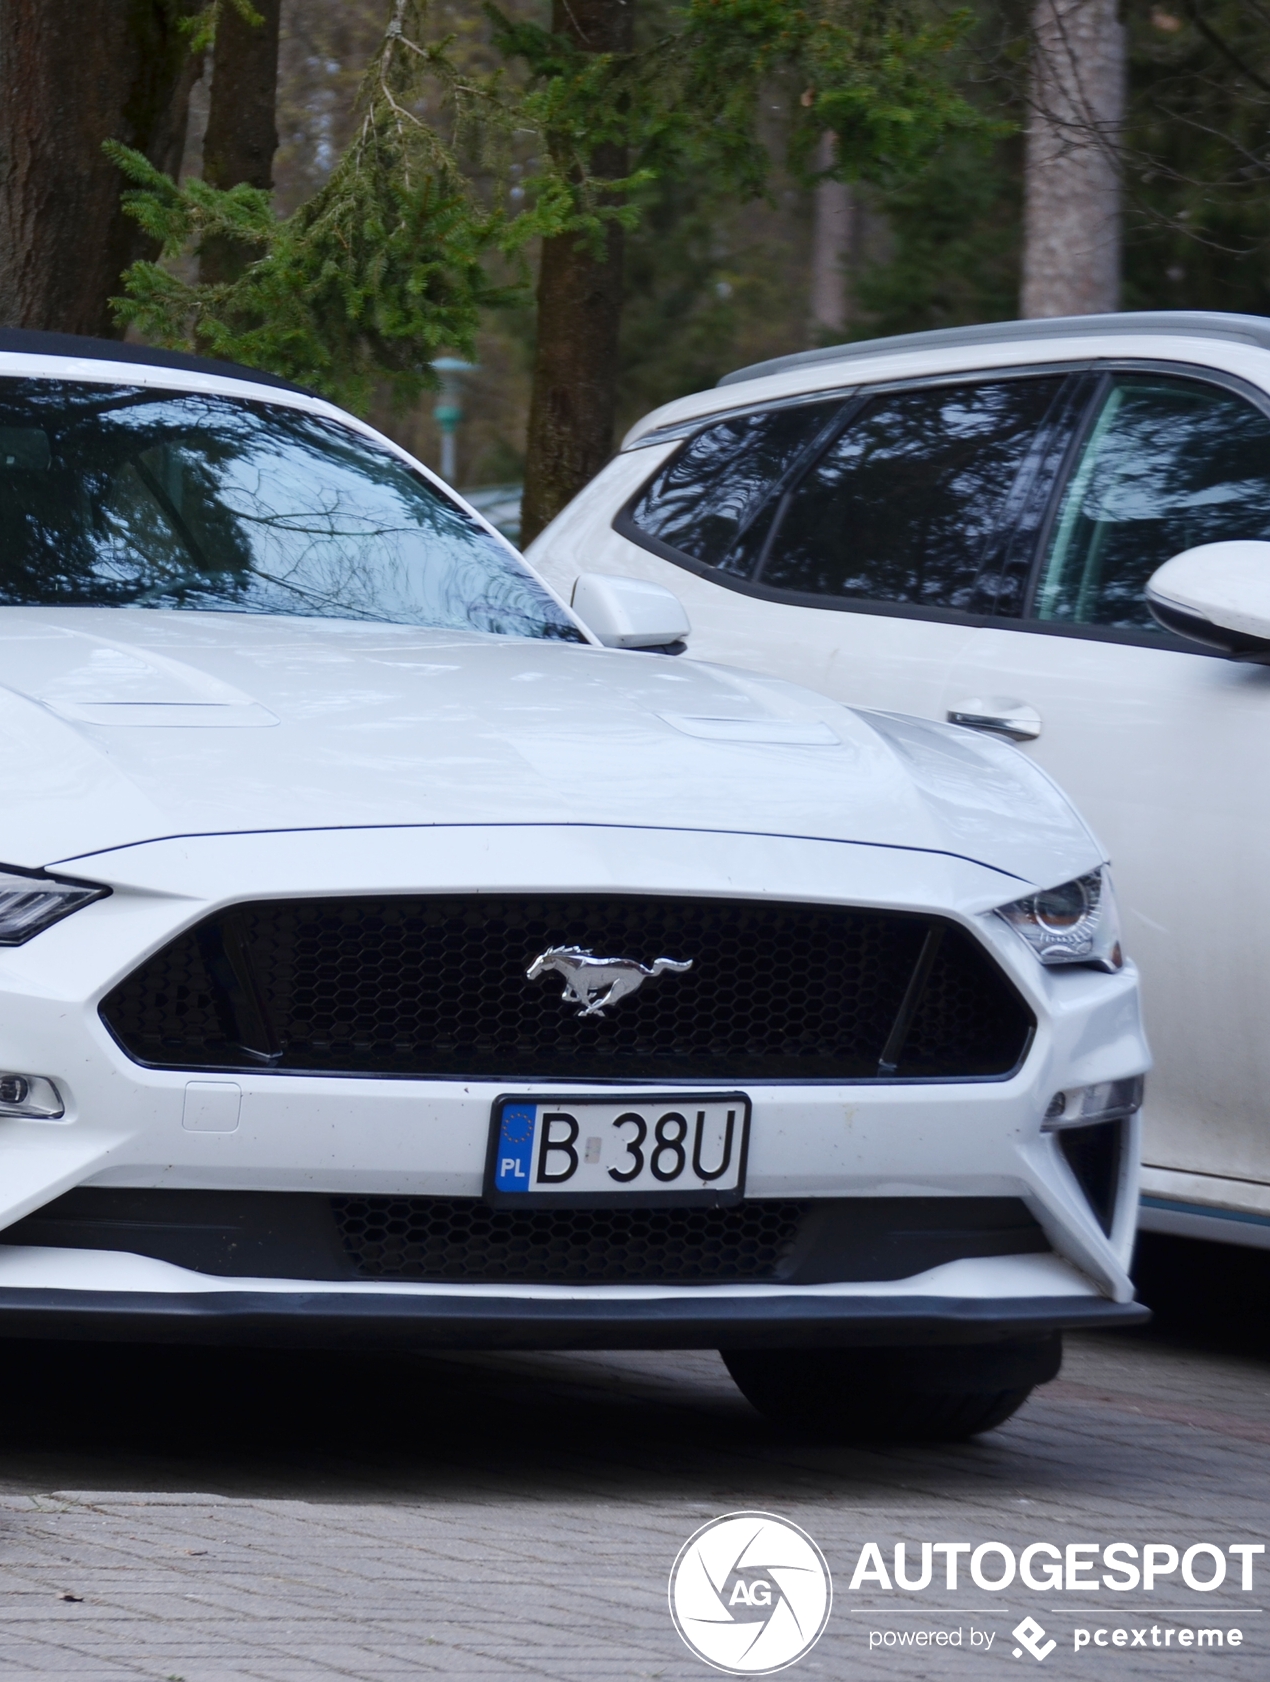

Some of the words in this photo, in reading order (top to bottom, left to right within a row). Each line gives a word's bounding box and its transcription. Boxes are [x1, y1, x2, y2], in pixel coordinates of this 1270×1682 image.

[500, 1158, 526, 1178] PL
[536, 1112, 580, 1183] B
[607, 1110, 736, 1183] 38U
